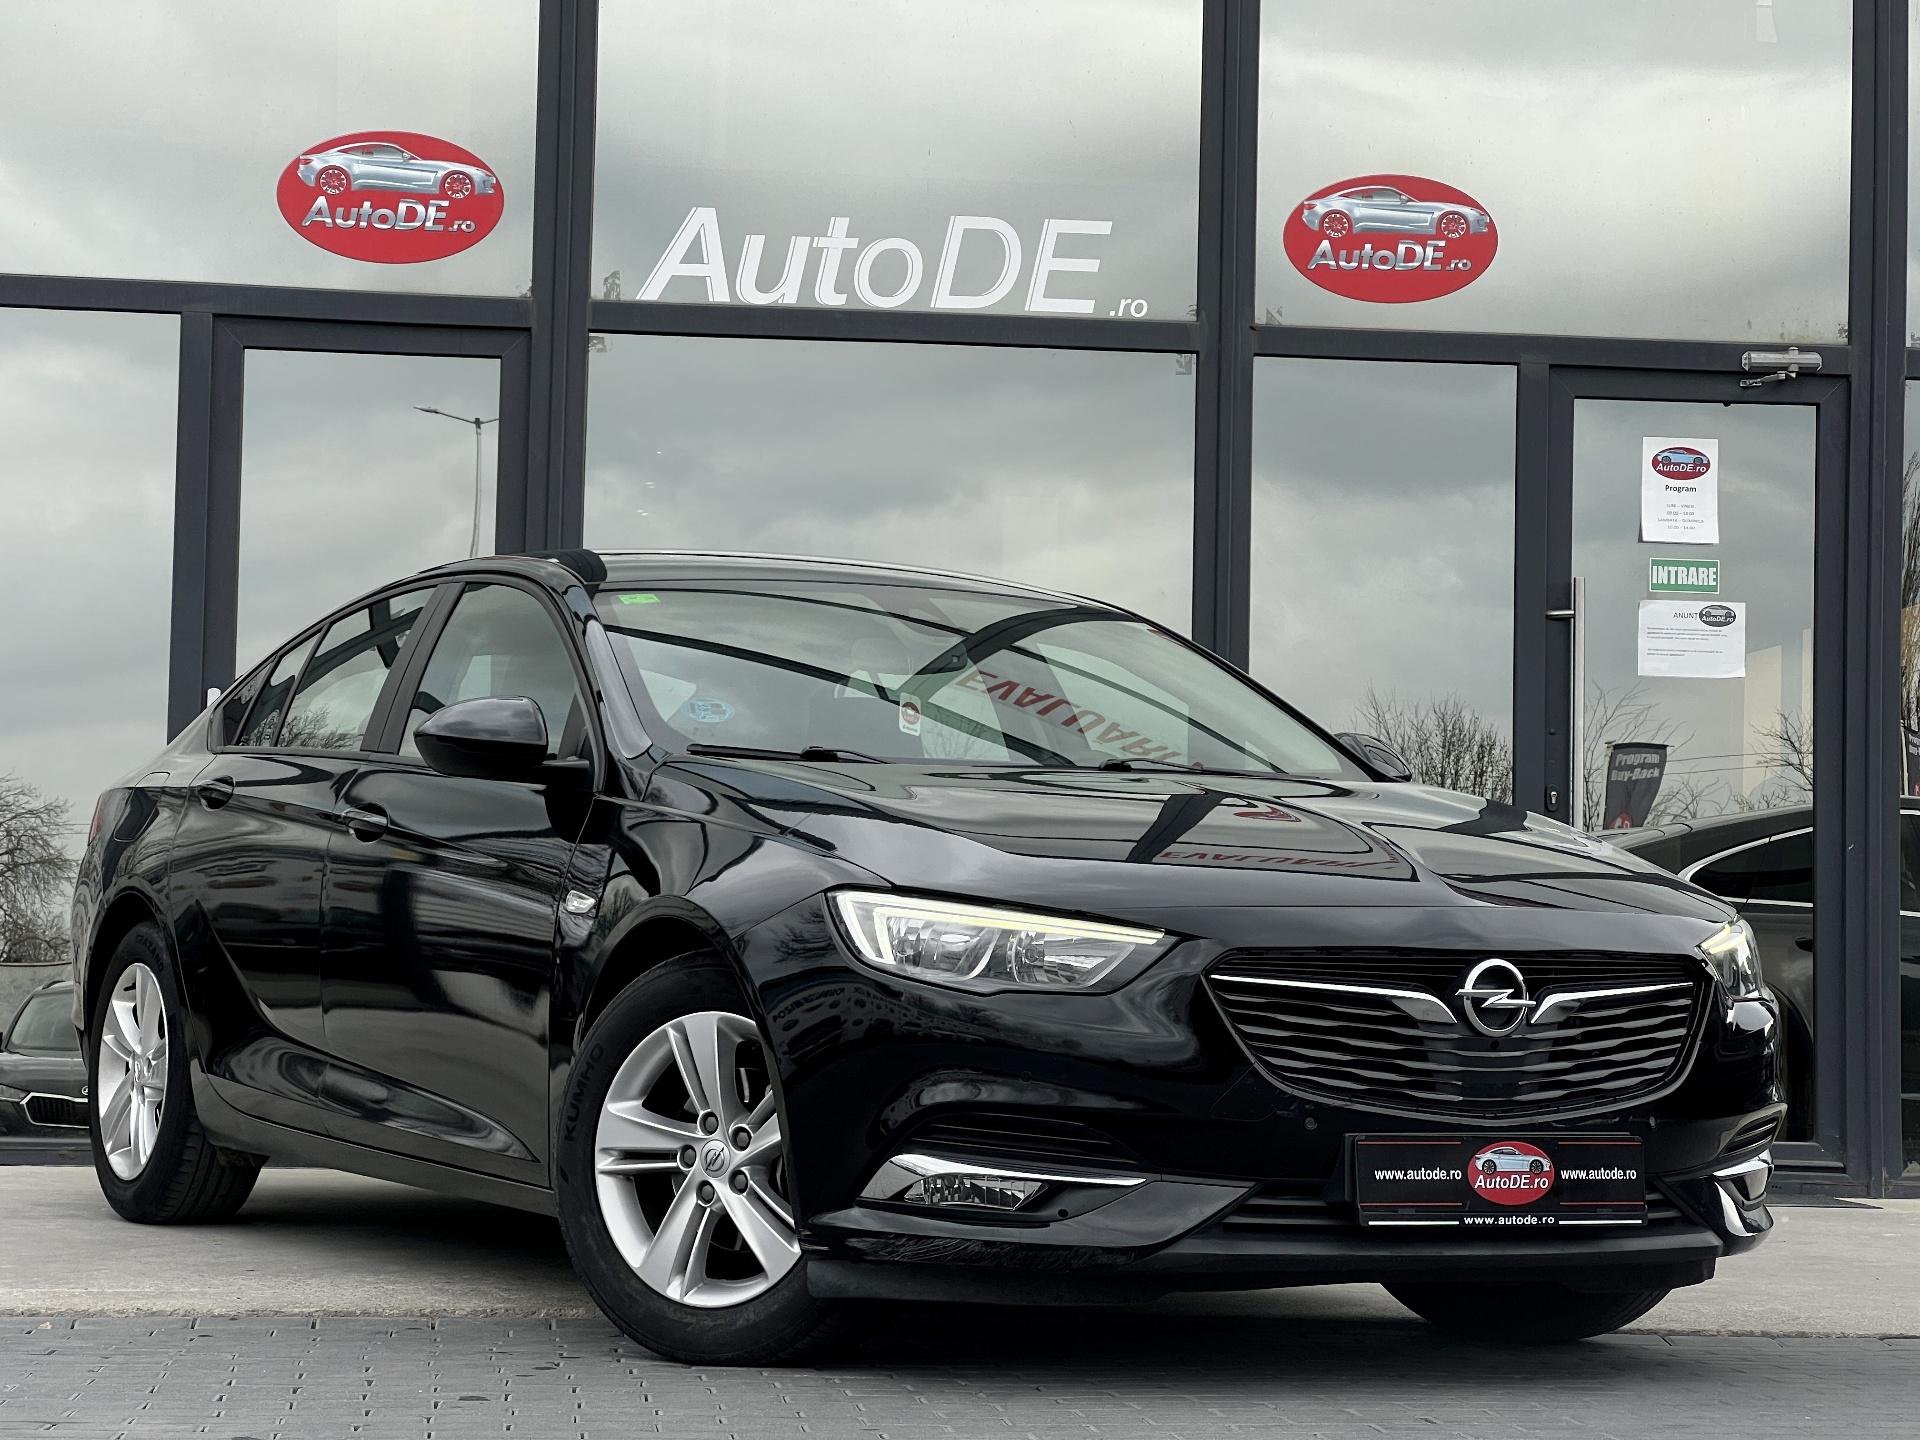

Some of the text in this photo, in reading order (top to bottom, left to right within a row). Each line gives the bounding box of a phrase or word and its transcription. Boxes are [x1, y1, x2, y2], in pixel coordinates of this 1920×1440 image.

[1655, 463, 1707, 473] AutoDE.ro
[1665, 484, 1697, 493] Program
[1652, 565, 1717, 586] INTRARE
[1615, 753, 1660, 767] Program
[564, 1043, 604, 1142] KUMHO
[1374, 1167, 1462, 1180] www.autode.ro
[1560, 1168, 1637, 1180] www.autode.ro
[1474, 1174, 1549, 1189] AutoDE.ro
[1463, 1214, 1555, 1225] www.autode.ro
